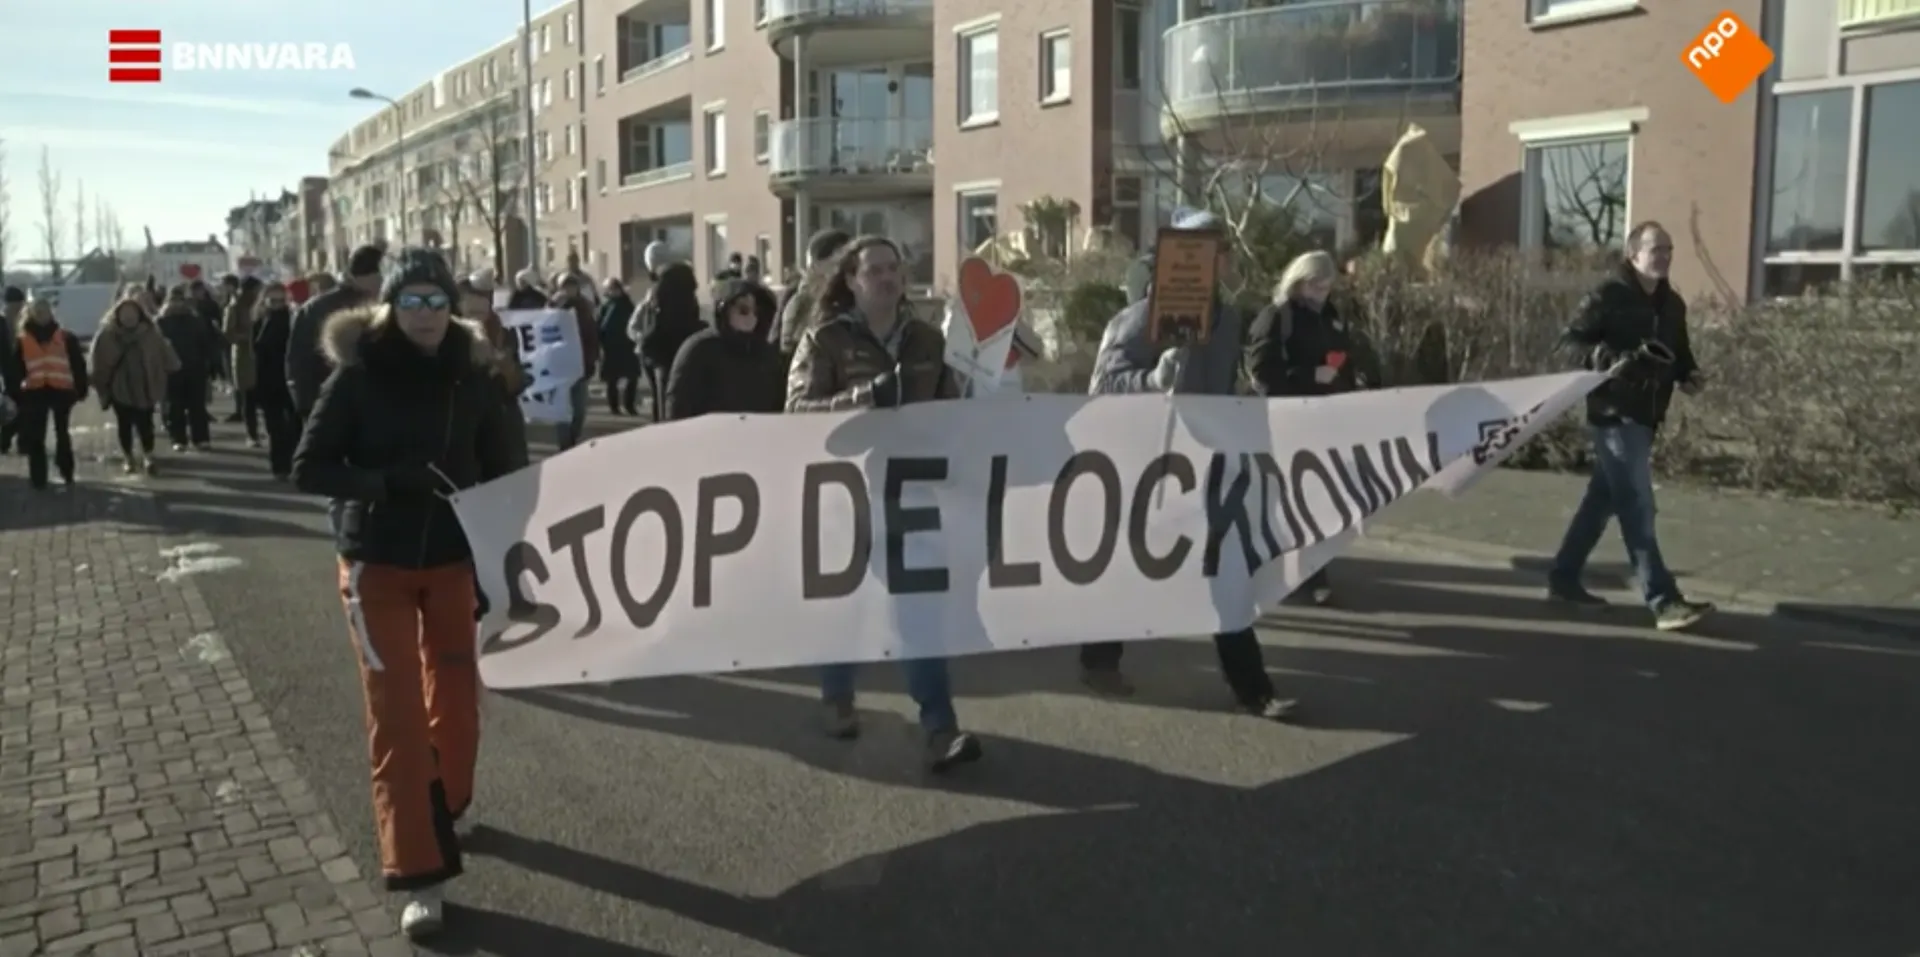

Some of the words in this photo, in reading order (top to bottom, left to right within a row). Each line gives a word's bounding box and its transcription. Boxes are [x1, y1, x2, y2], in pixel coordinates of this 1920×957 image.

[480, 472, 761, 656] STOP
[802, 456, 950, 600] DE
[986, 431, 1442, 588] LOCKDOWN
